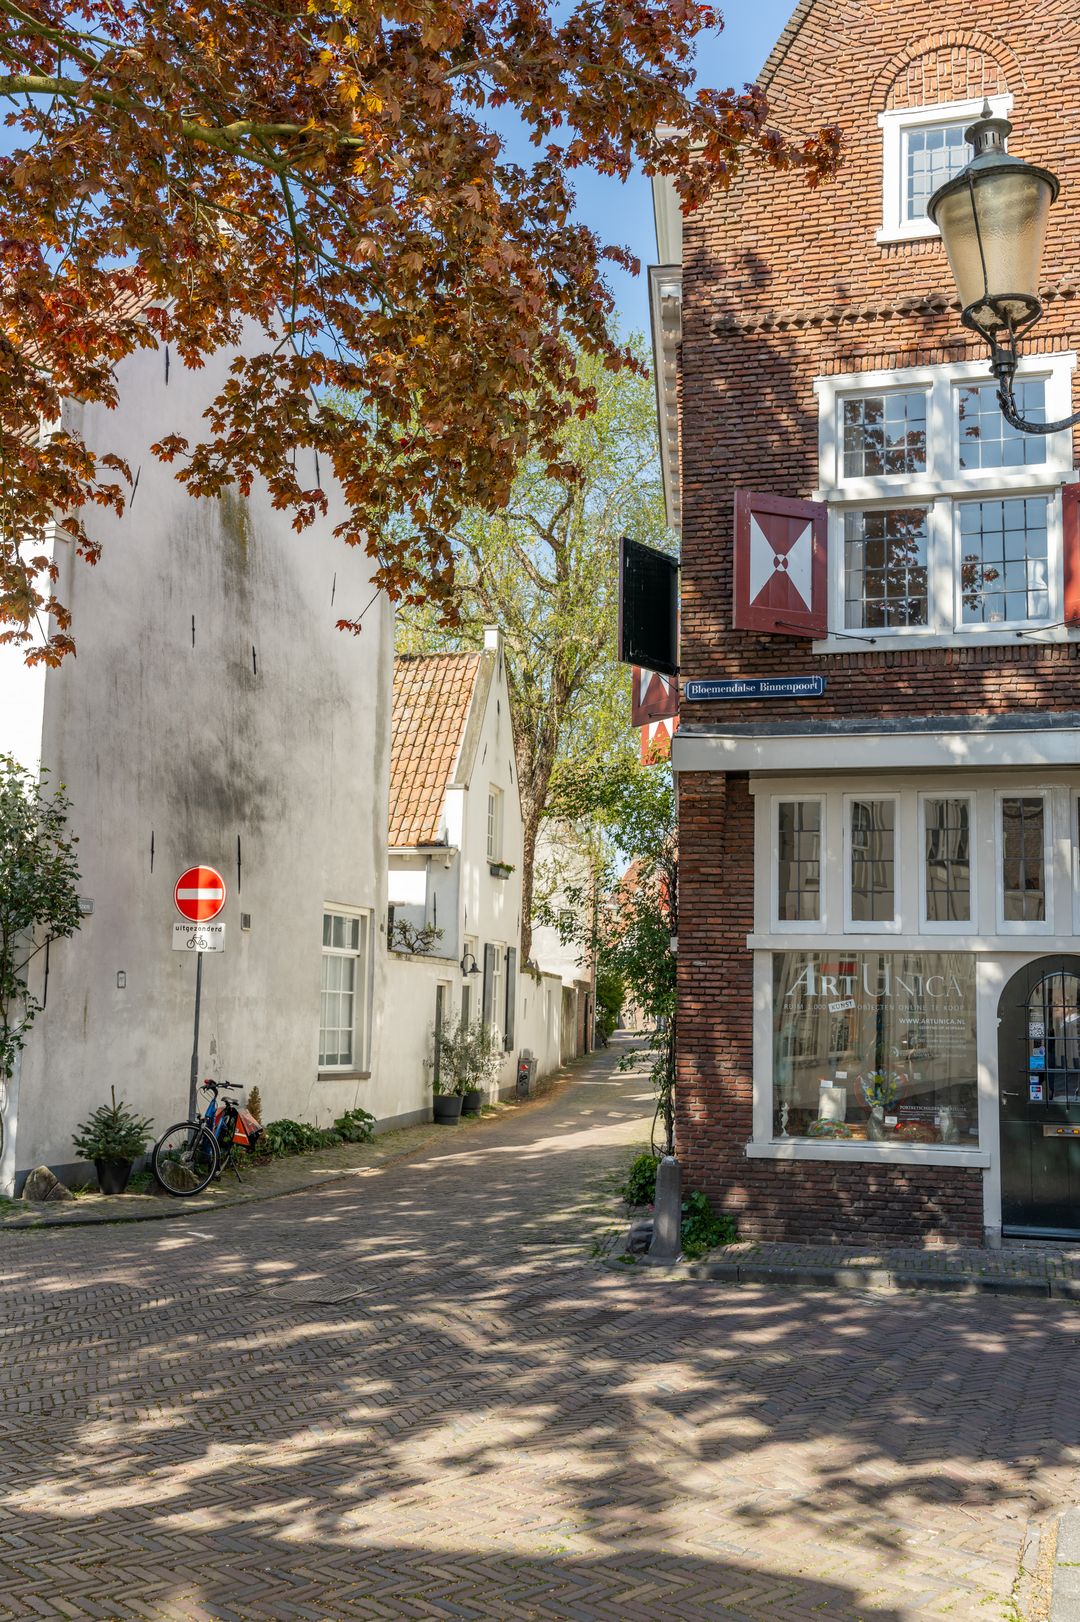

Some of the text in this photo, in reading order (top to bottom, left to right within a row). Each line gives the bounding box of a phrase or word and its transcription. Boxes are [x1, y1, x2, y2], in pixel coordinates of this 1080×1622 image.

[691, 681, 818, 695] Bloemendalse Binnenpoort
[175, 925, 222, 933] uitgezonderd
[831, 1000, 853, 1011] KUNST
